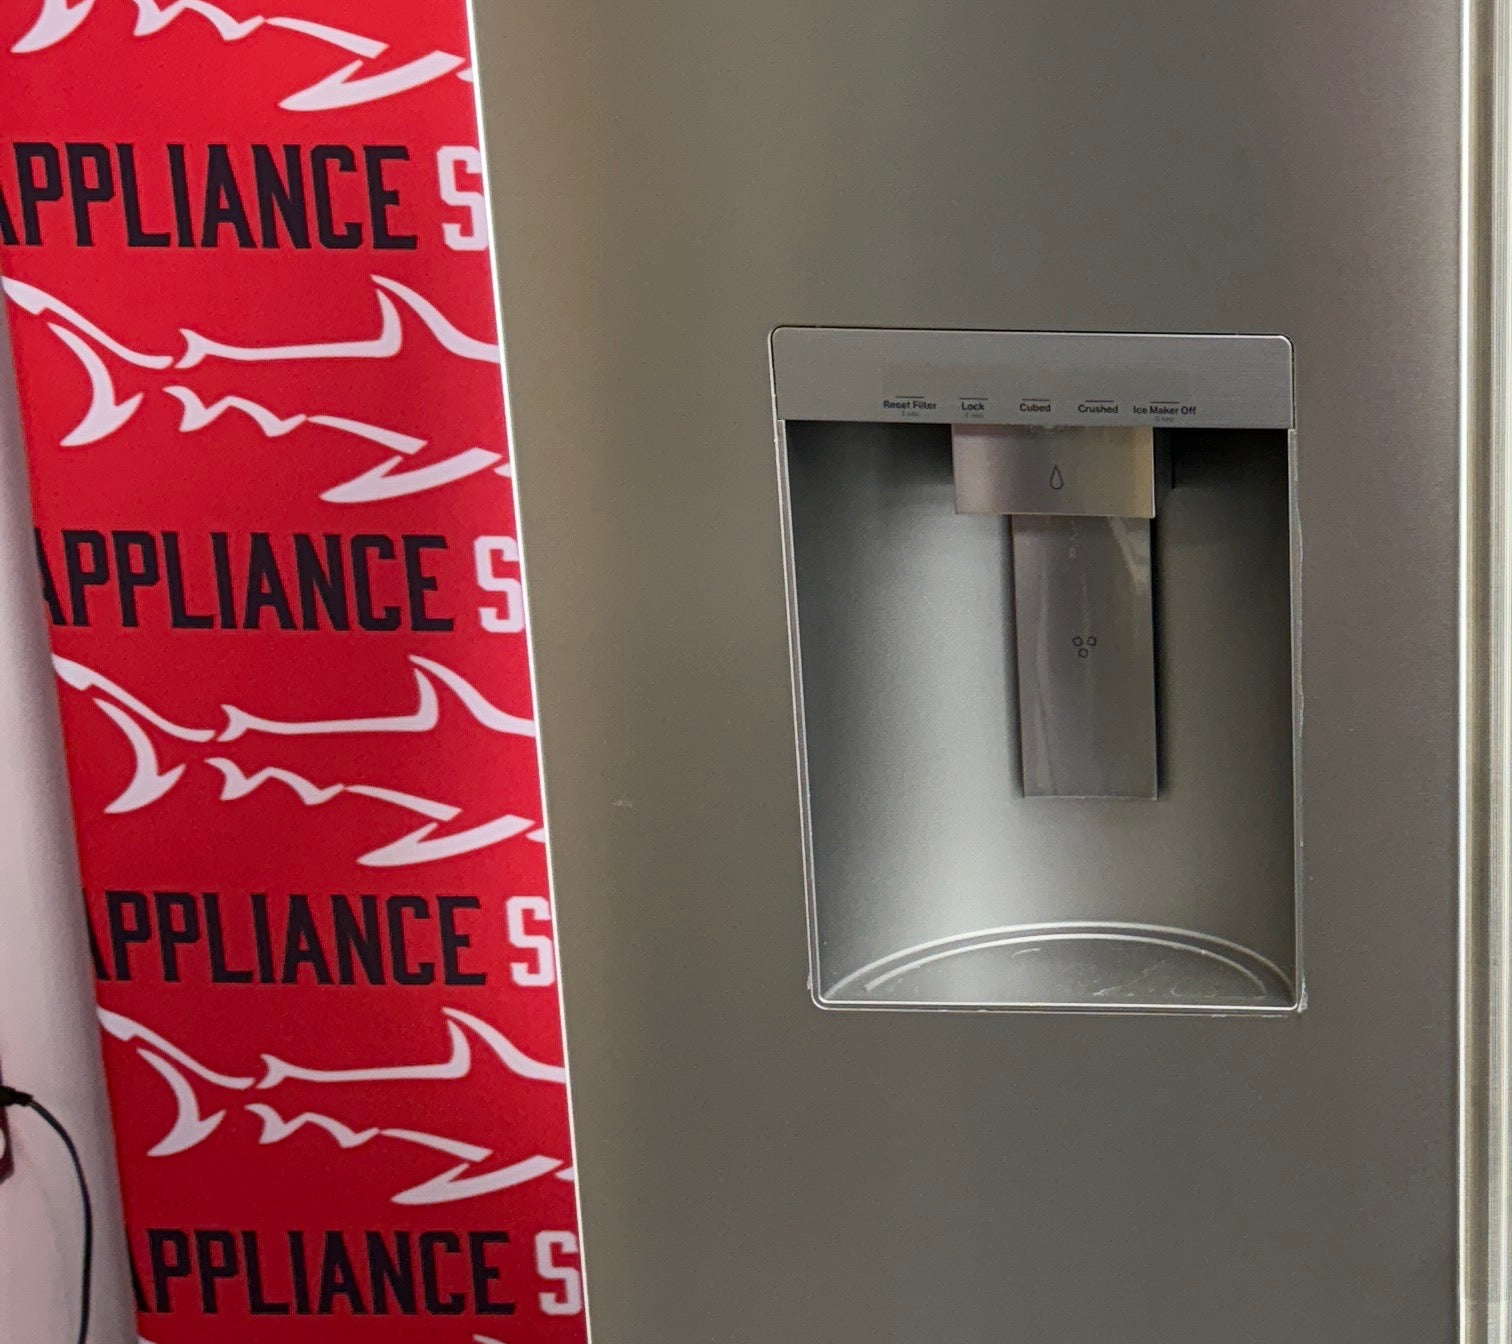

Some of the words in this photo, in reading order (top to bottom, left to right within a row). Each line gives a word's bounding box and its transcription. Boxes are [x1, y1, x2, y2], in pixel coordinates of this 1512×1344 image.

[961, 402, 985, 411] Lock
[1019, 403, 1051, 413] Cubed
[1078, 404, 1119, 414] Crushed
[1133, 405, 1147, 415] Ice
[1149, 406, 1179, 415] Maker
[1181, 406, 1197, 416] Off
[82, 890, 488, 987] PPLIANCE
[125, 1228, 517, 1316] PPLIANCE
